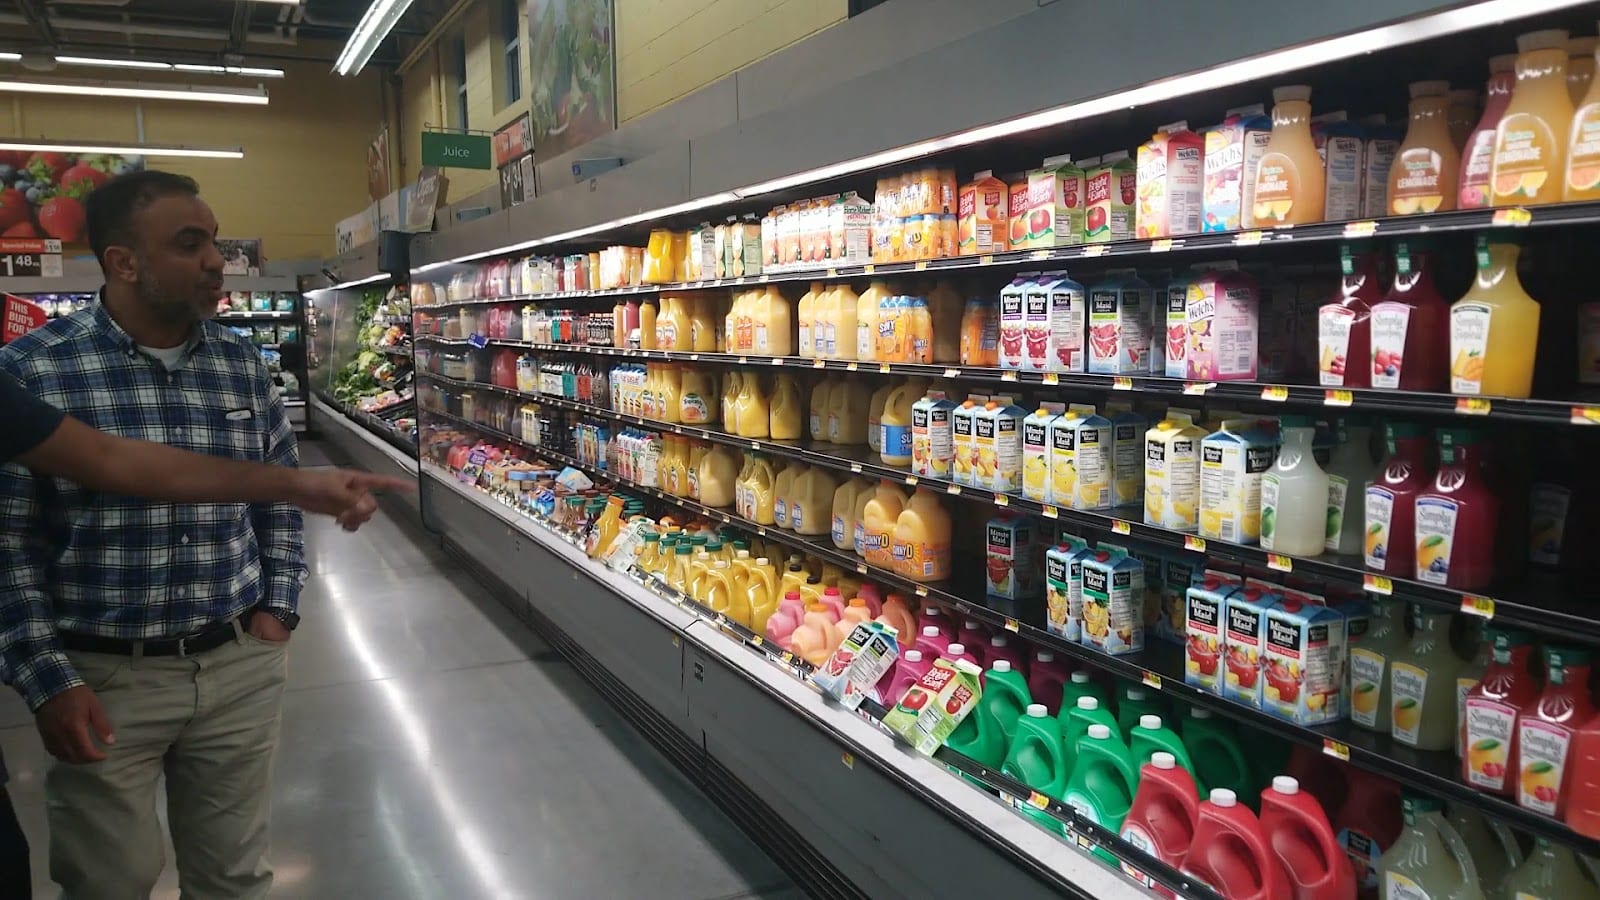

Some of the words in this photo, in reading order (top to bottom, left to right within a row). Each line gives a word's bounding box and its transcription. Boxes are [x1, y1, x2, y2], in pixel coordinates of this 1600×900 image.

[443, 146, 470, 158] Juice
[1207, 146, 1242, 170] Welch's
[1138, 161, 1166, 181] Welch's
[1089, 176, 1107, 189] Bright
[1397, 175, 1438, 189] LEMONADE
[1090, 187, 1107, 201] Early
[15, 254, 33, 267] 48
[1003, 295, 1021, 304] Minute
[1028, 295, 1046, 304] Minute
[1094, 294, 1115, 302] Minute
[10, 301, 28, 315] THIS
[1005, 302, 1019, 310] Maid
[1030, 302, 1044, 311] Maid
[1096, 302, 1112, 310] Maid
[1188, 301, 1215, 320] Welch's
[9, 311, 34, 326] BUD'S
[7, 322, 25, 334] FOR
[955, 416, 971, 425] Minute
[976, 418, 993, 428] Minute
[957, 423, 969, 432] Maid
[978, 426, 991, 435] Maid
[1026, 425, 1044, 436] Minute
[1054, 428, 1073, 439] Minute
[1027, 433, 1041, 442] Maid
[1056, 437, 1071, 446] Maid
[990, 528, 1009, 538] Minute
[991, 535, 1006, 544] Maid
[1048, 558, 1065, 571] Minute
[1050, 567, 1063, 578] Maid
[1085, 568, 1106, 582] Minute
[1087, 577, 1103, 588] Maid
[1191, 598, 1217, 614] Minute
[1193, 608, 1212, 621] Maid
[1230, 607, 1257, 625] Minute
[1232, 618, 1253, 631] Maid
[1269, 619, 1298, 637] Minute
[1272, 631, 1294, 645] Maid
[1353, 655, 1380, 677] Simply
[927, 667, 951, 681] Bright
[1394, 669, 1422, 691] Simply
[1470, 708, 1508, 732] Simply
[1524, 729, 1562, 756] Simply
